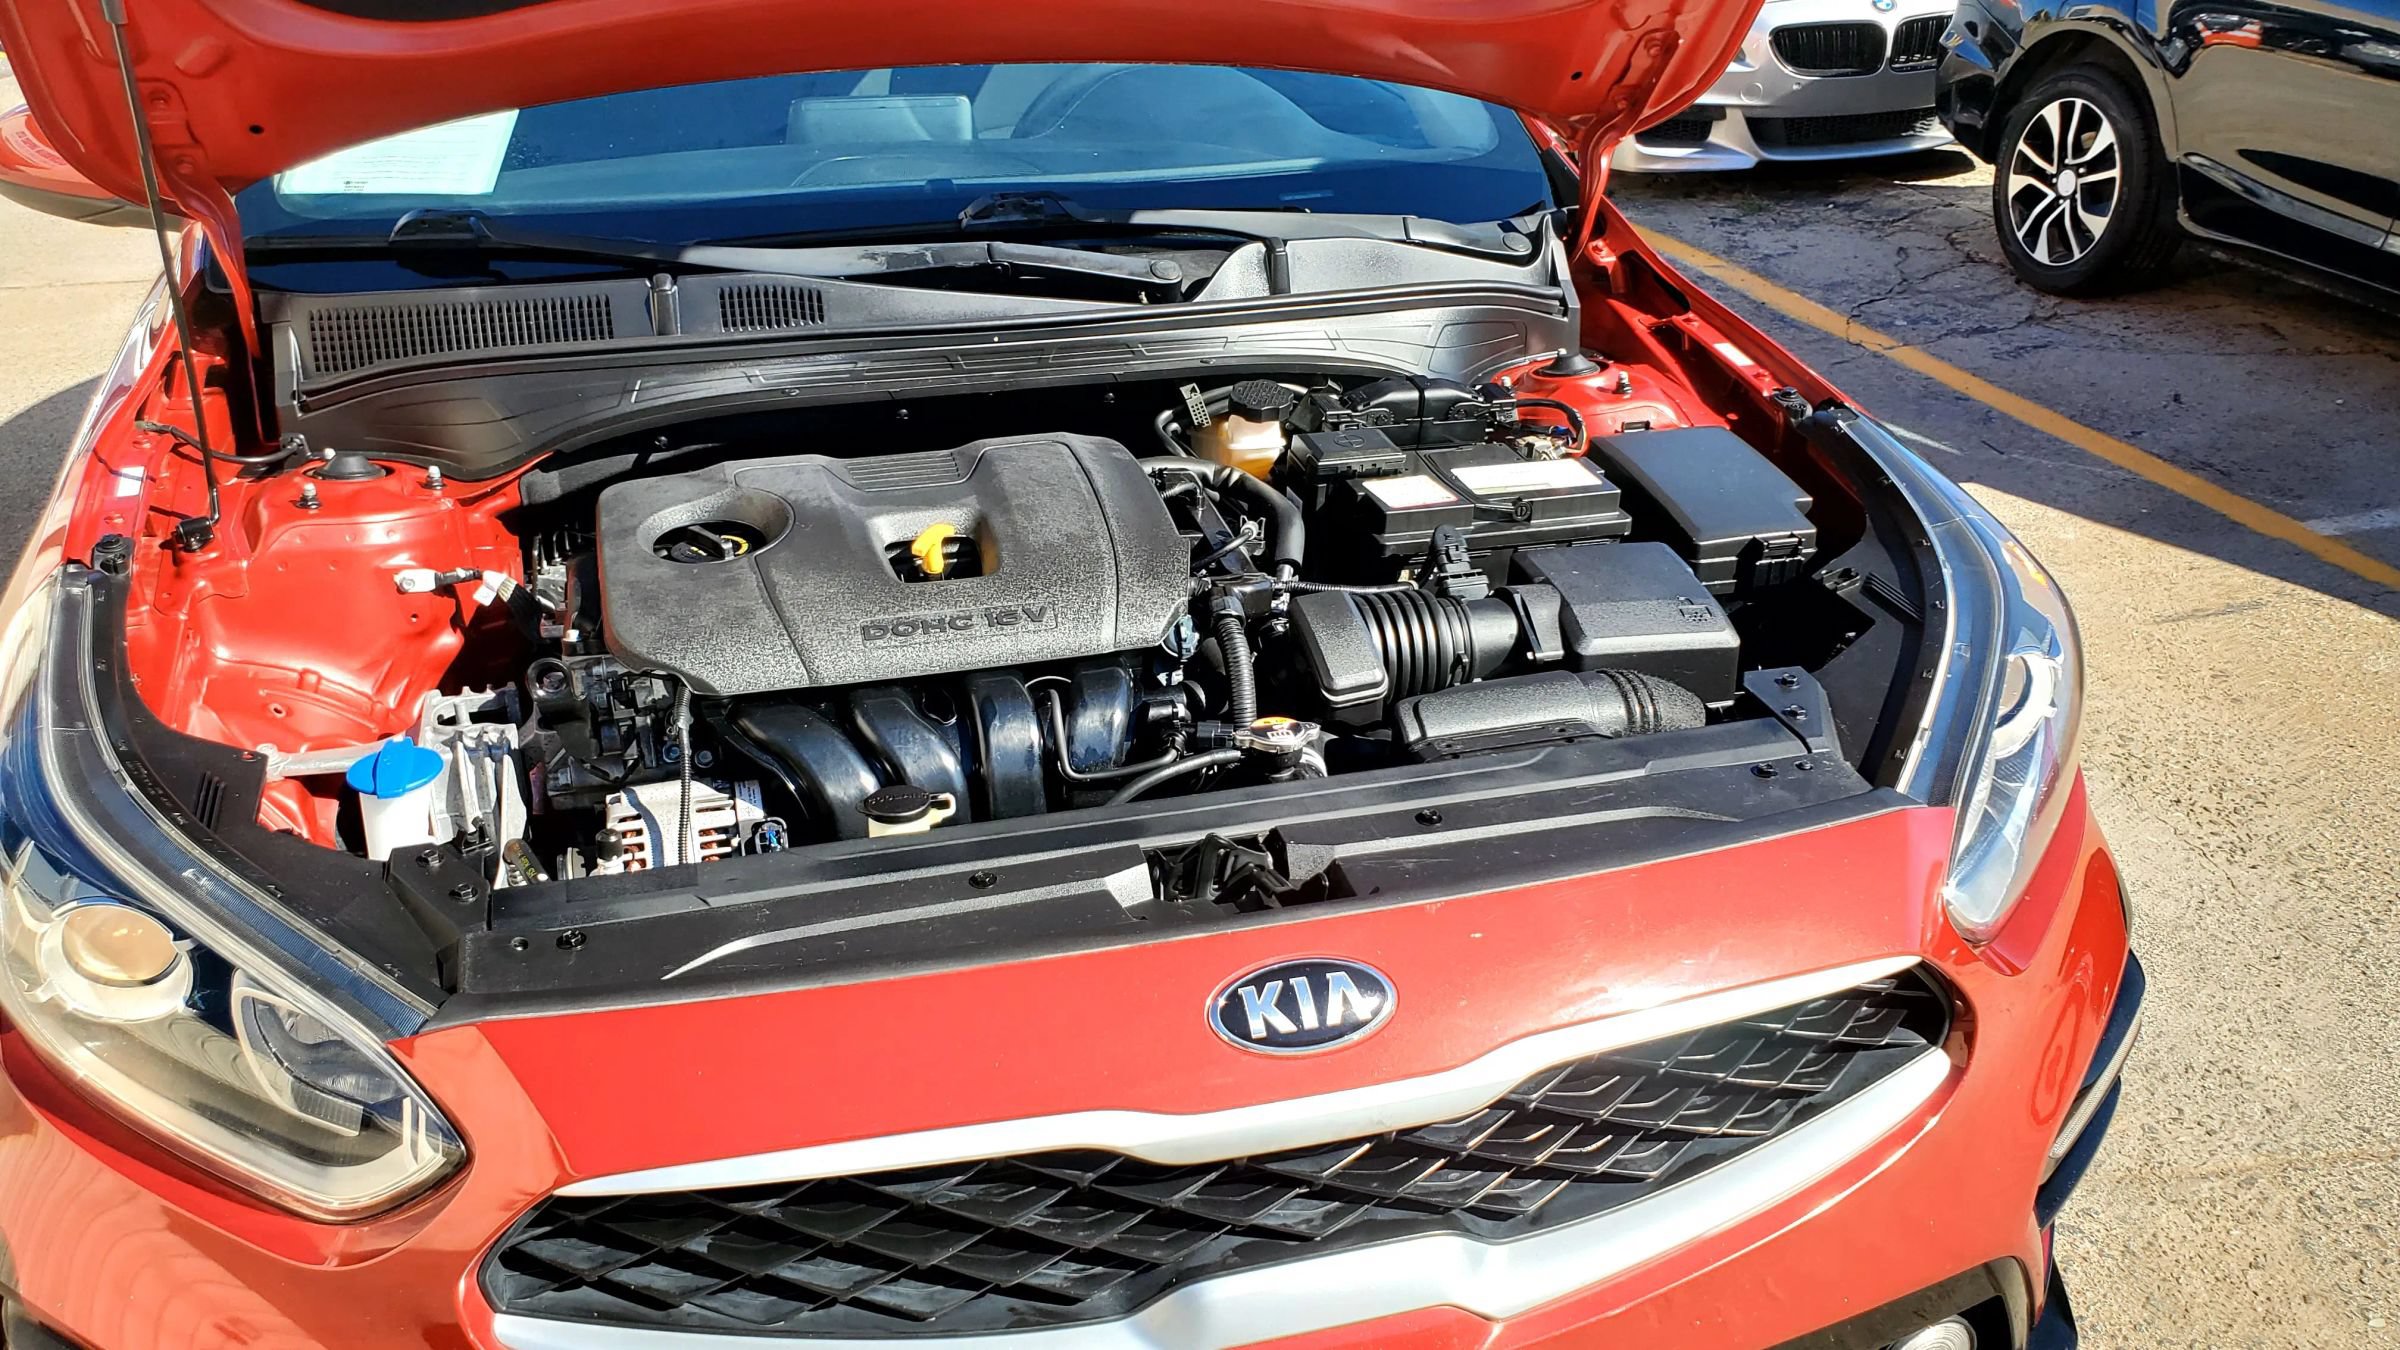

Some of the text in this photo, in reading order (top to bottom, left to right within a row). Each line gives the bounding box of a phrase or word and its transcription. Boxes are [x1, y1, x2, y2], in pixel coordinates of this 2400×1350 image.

[863, 605, 1048, 641] DOHC 16V
[1238, 970, 1373, 1040] KIA
